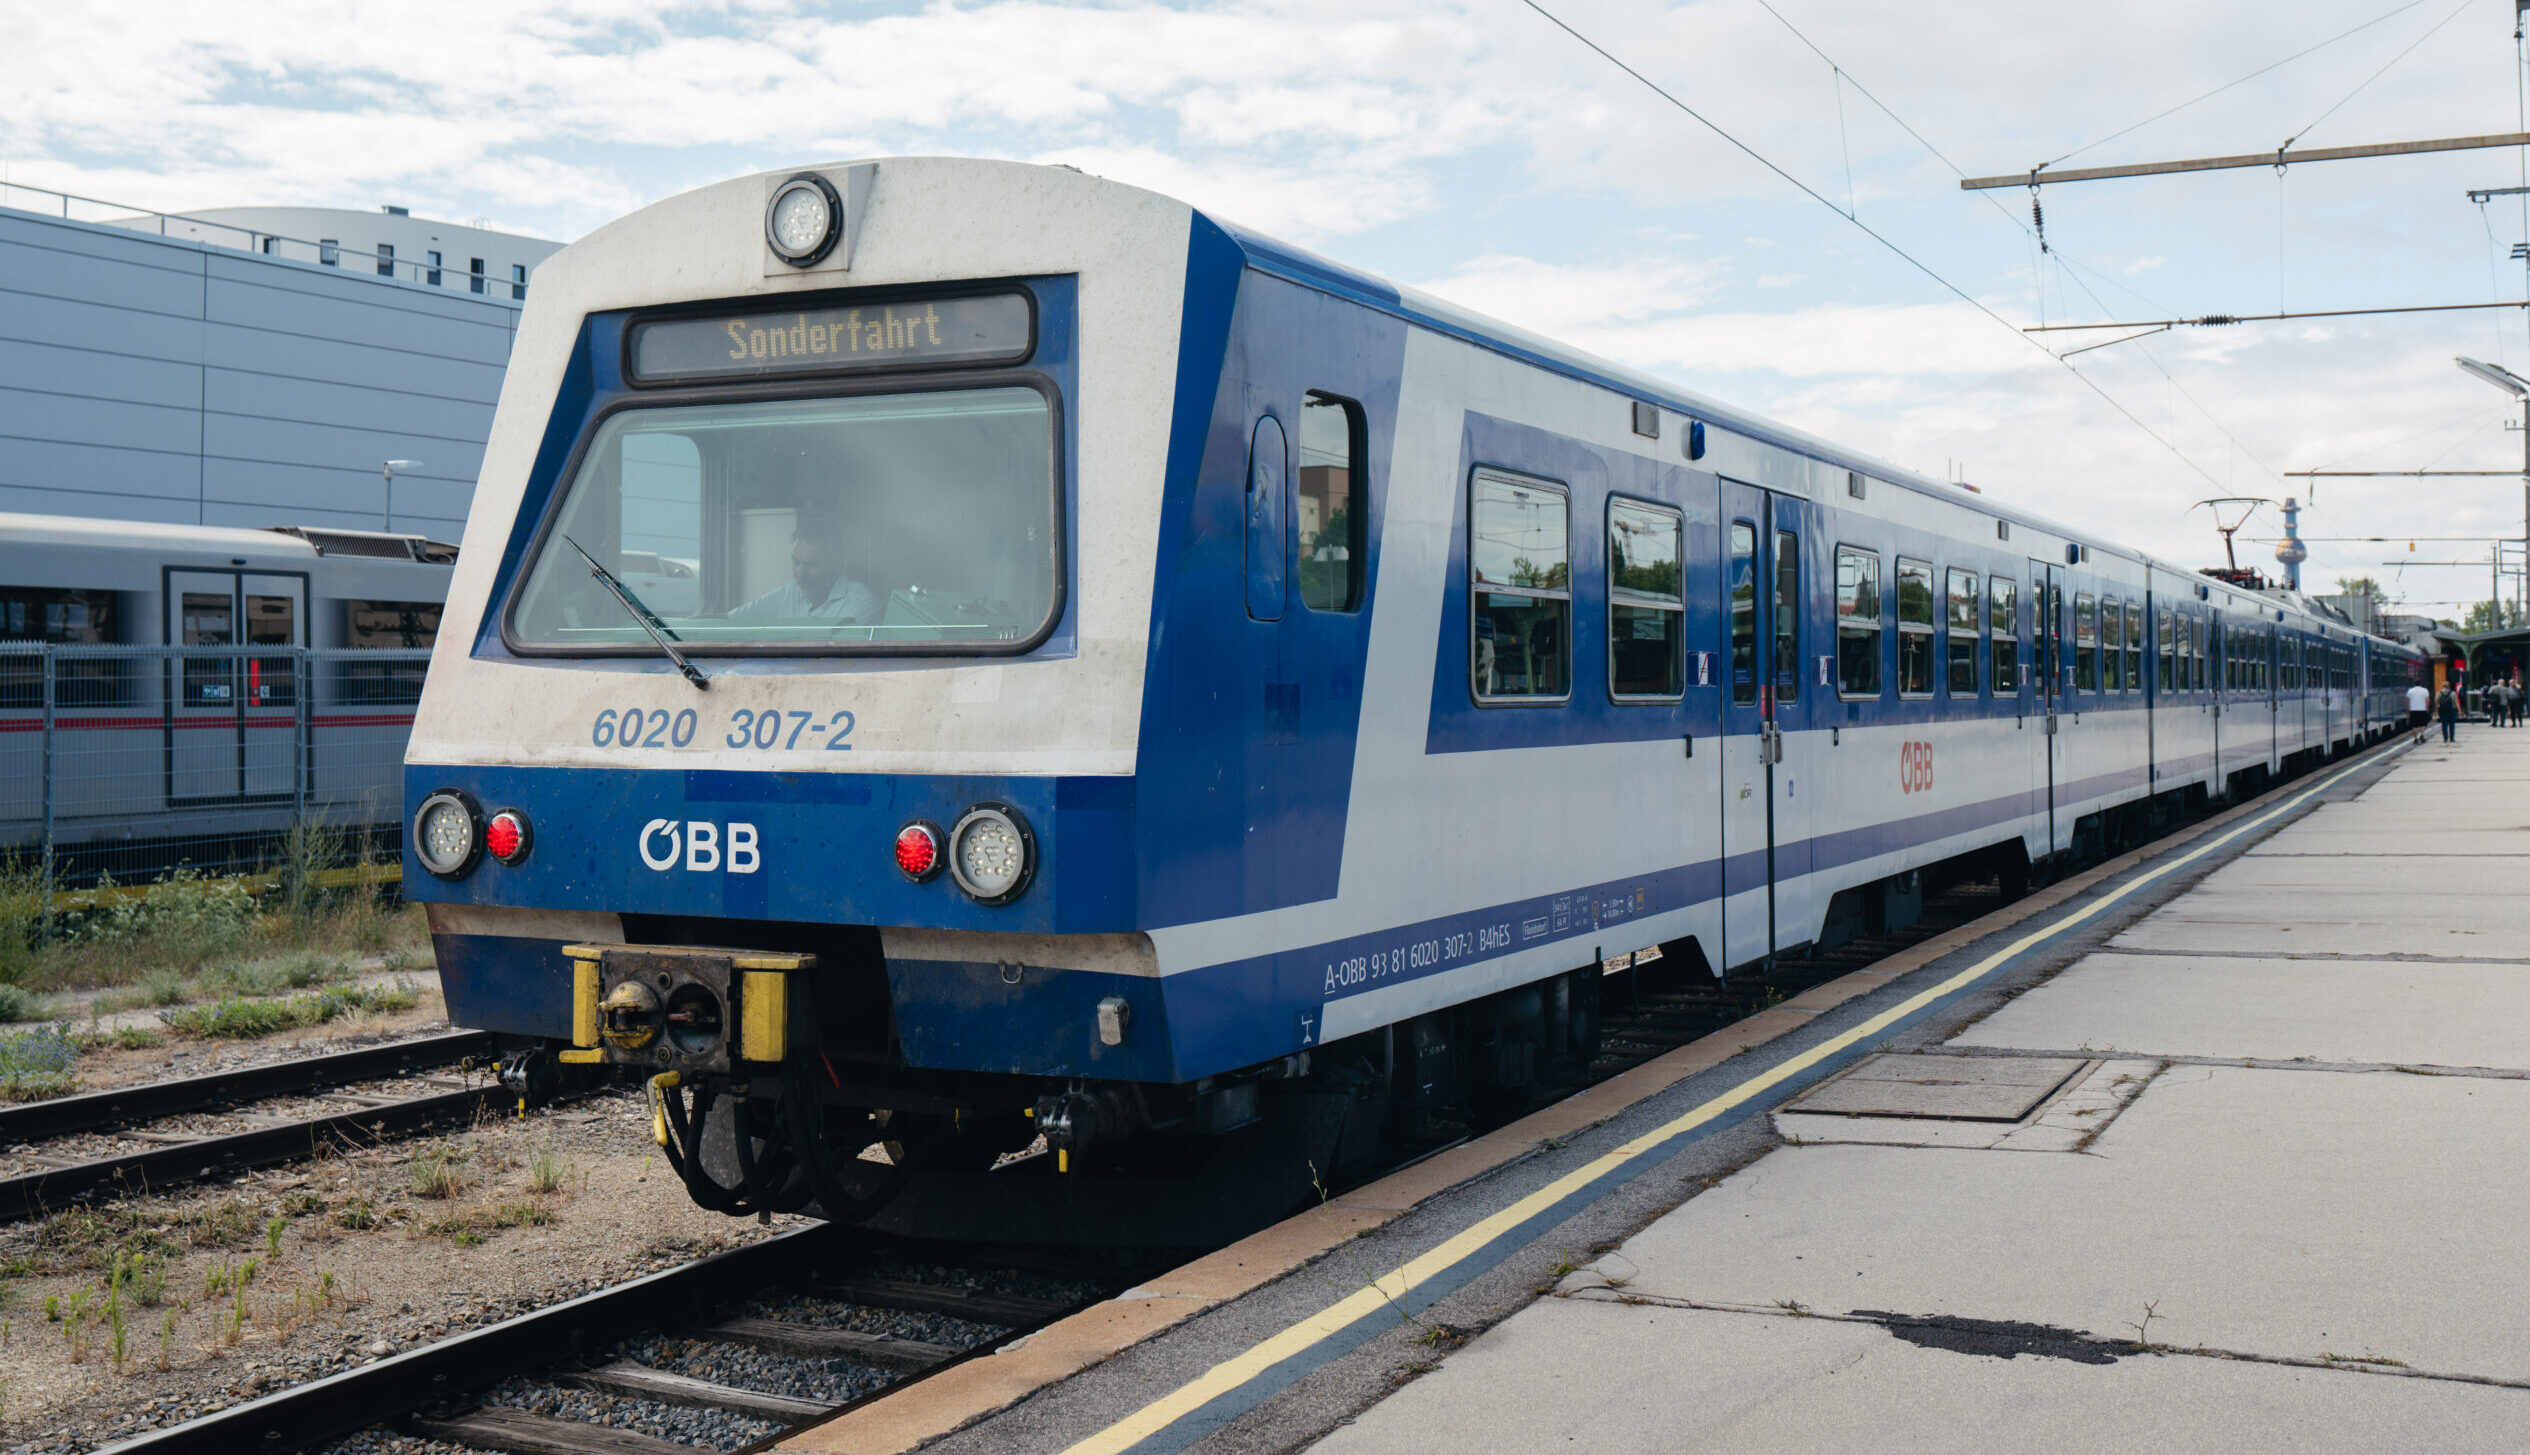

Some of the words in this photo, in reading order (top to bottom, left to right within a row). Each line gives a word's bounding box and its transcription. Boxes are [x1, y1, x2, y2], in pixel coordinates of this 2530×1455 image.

[728, 304, 942, 360] Sonderfahrt
[592, 708, 698, 748] 6020
[726, 709, 856, 751] 307-2
[1901, 741, 1933, 795] ÖBB
[639, 818, 761, 873] ÖBB
[1371, 953, 1387, 979] 93
[1392, 947, 1405, 973] 81
[1410, 940, 1439, 968] 6020
[1444, 932, 1473, 959] 307-2
[1480, 923, 1510, 952] B4hES
